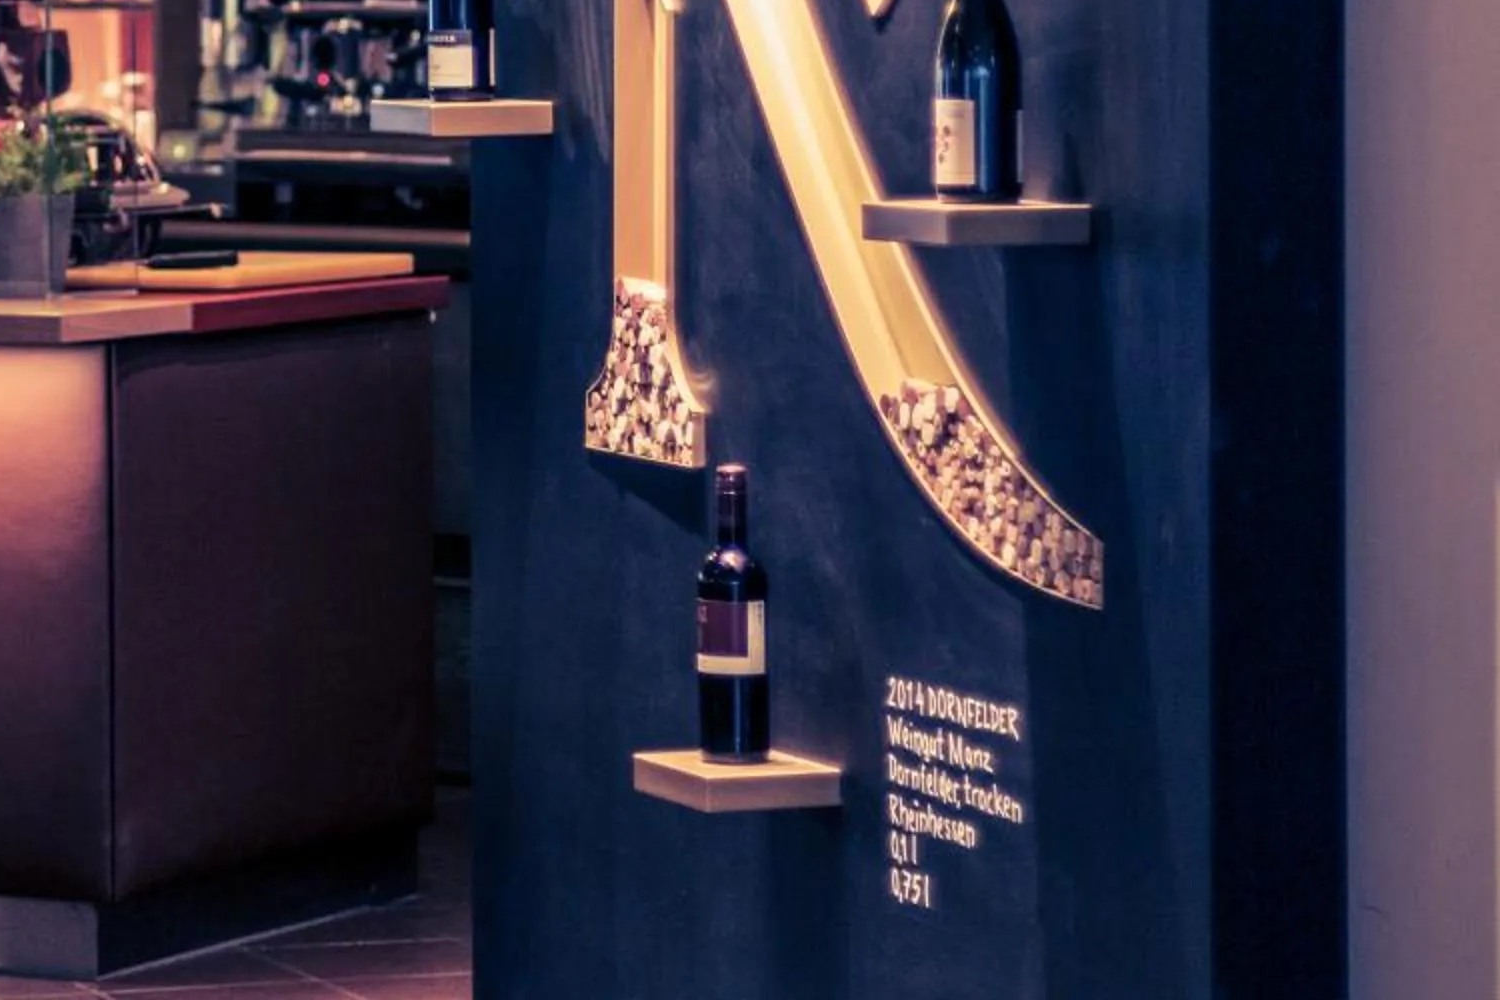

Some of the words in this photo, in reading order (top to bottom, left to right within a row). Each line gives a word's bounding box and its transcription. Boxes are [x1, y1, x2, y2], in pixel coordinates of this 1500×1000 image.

[886, 676, 925, 717] 2014
[927, 686, 1021, 741] DORNFELDER
[887, 715, 945, 763] Weingut
[948, 732, 995, 774] Manz
[888, 793, 977, 849] Rheinhessen
[963, 773, 1024, 825] trocken
